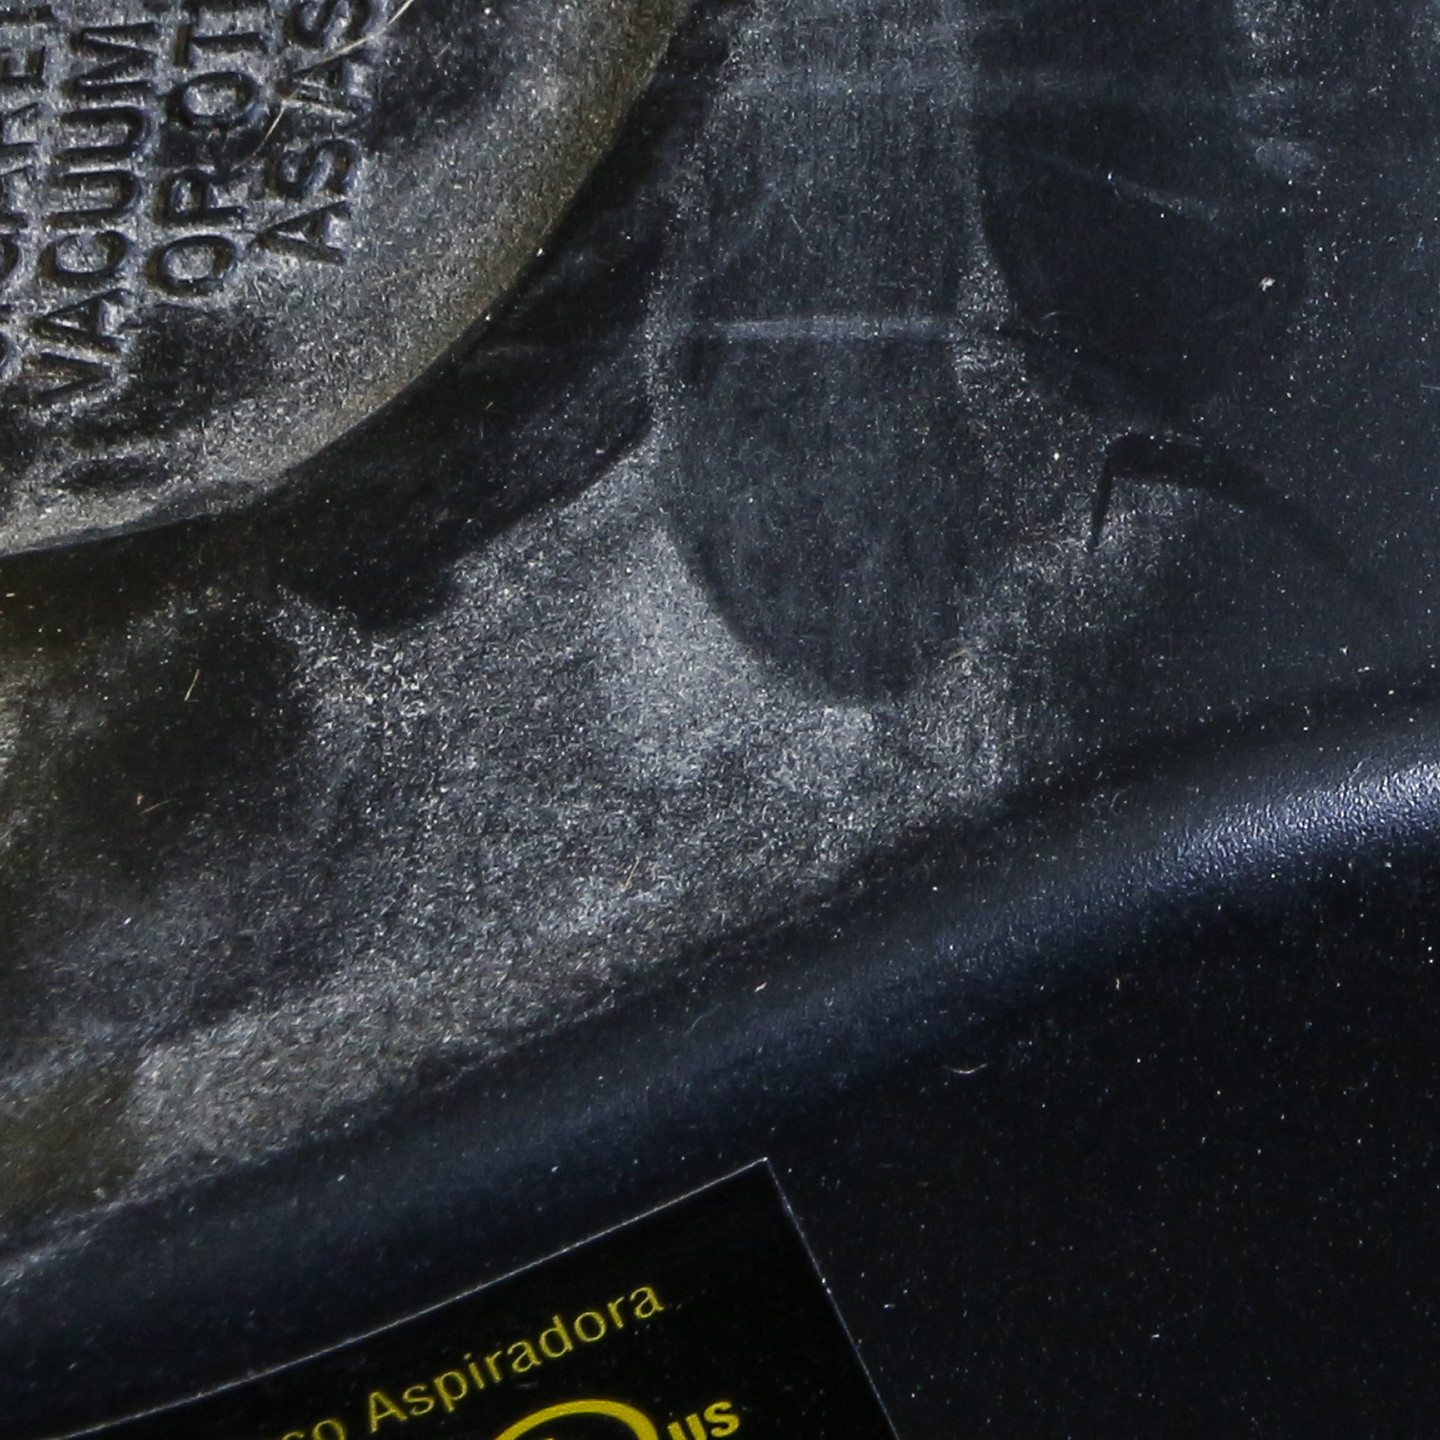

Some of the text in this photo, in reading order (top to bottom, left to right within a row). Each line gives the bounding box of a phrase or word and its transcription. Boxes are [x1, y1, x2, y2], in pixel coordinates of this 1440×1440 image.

[24, 23, 157, 410] VACUUM
[145, 160, 245, 302] OR
[255, 138, 350, 265] AS
[367, 1286, 665, 1434] Aspiradora
